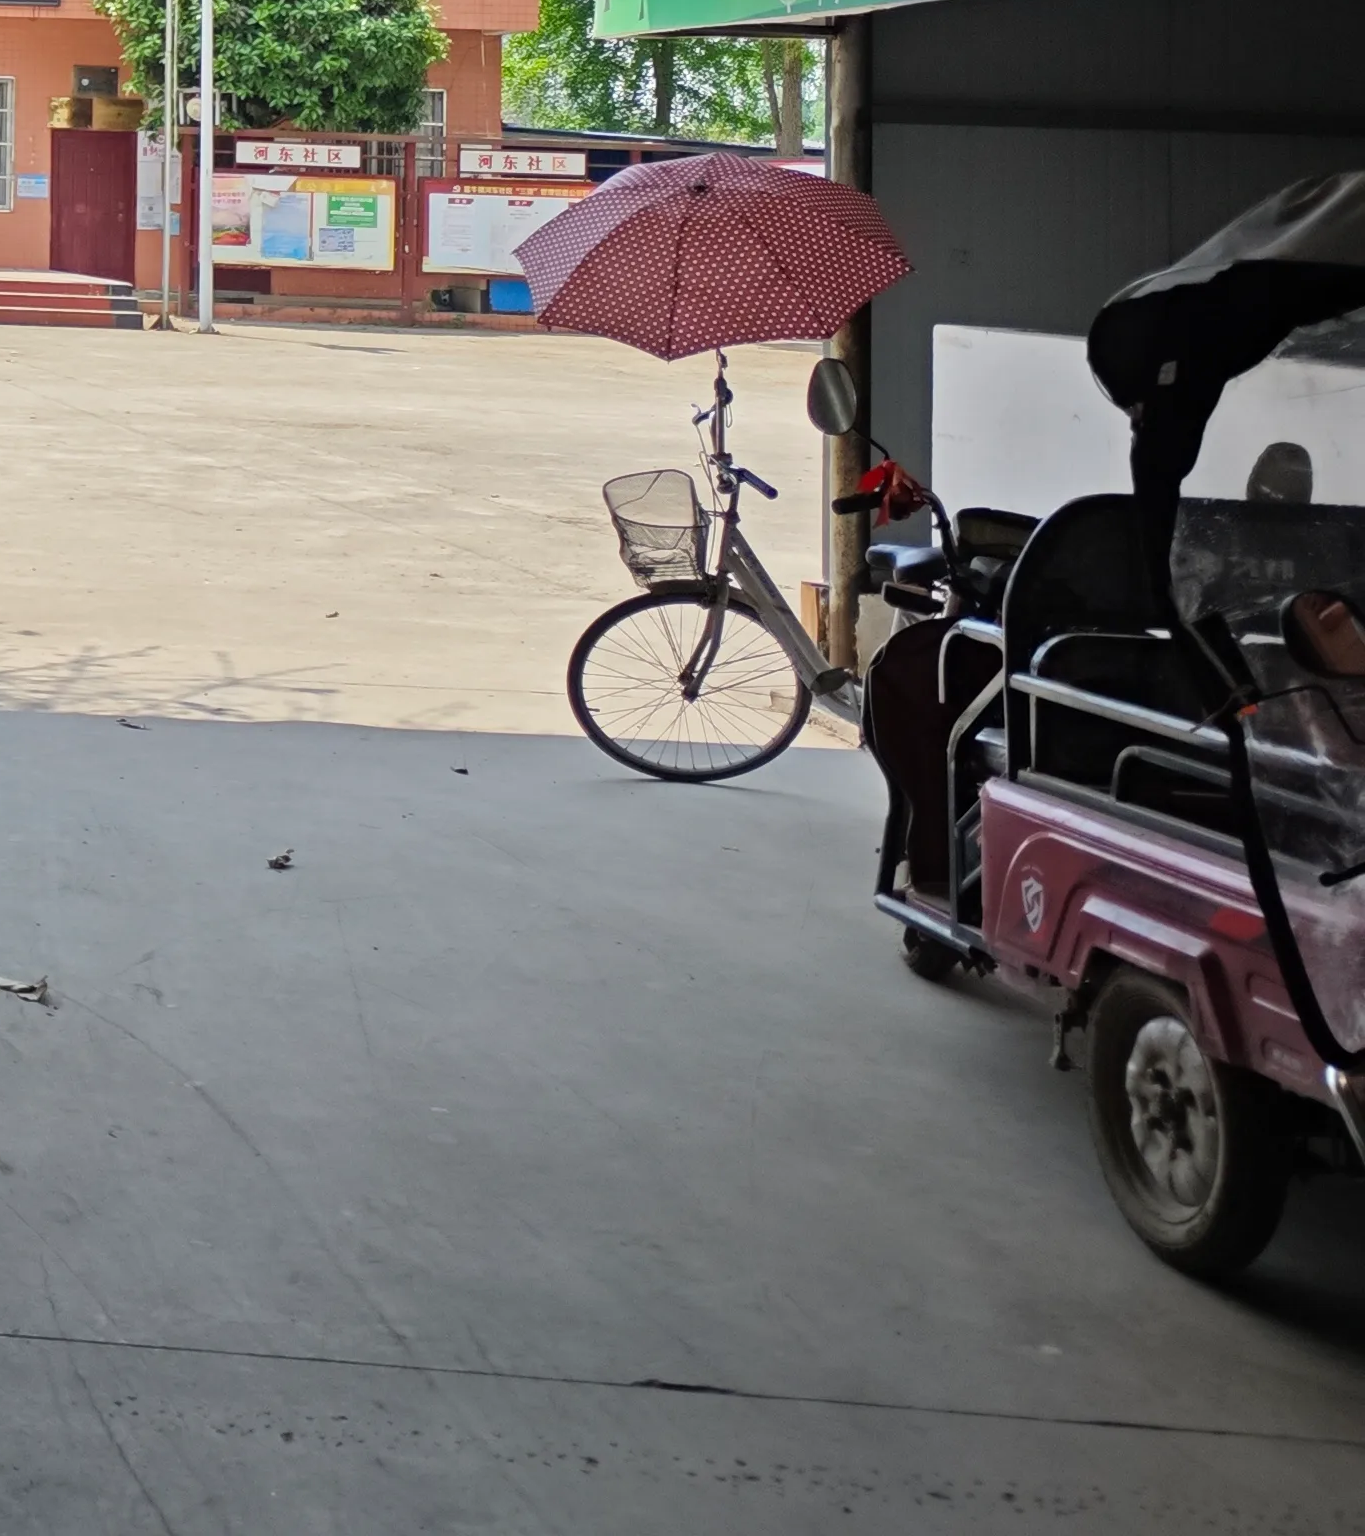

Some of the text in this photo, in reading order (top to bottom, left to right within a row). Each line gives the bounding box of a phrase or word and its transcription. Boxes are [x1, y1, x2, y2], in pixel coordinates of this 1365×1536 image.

[253, 145, 343, 164] 河东社区
[477, 154, 567, 172] 河东社区
